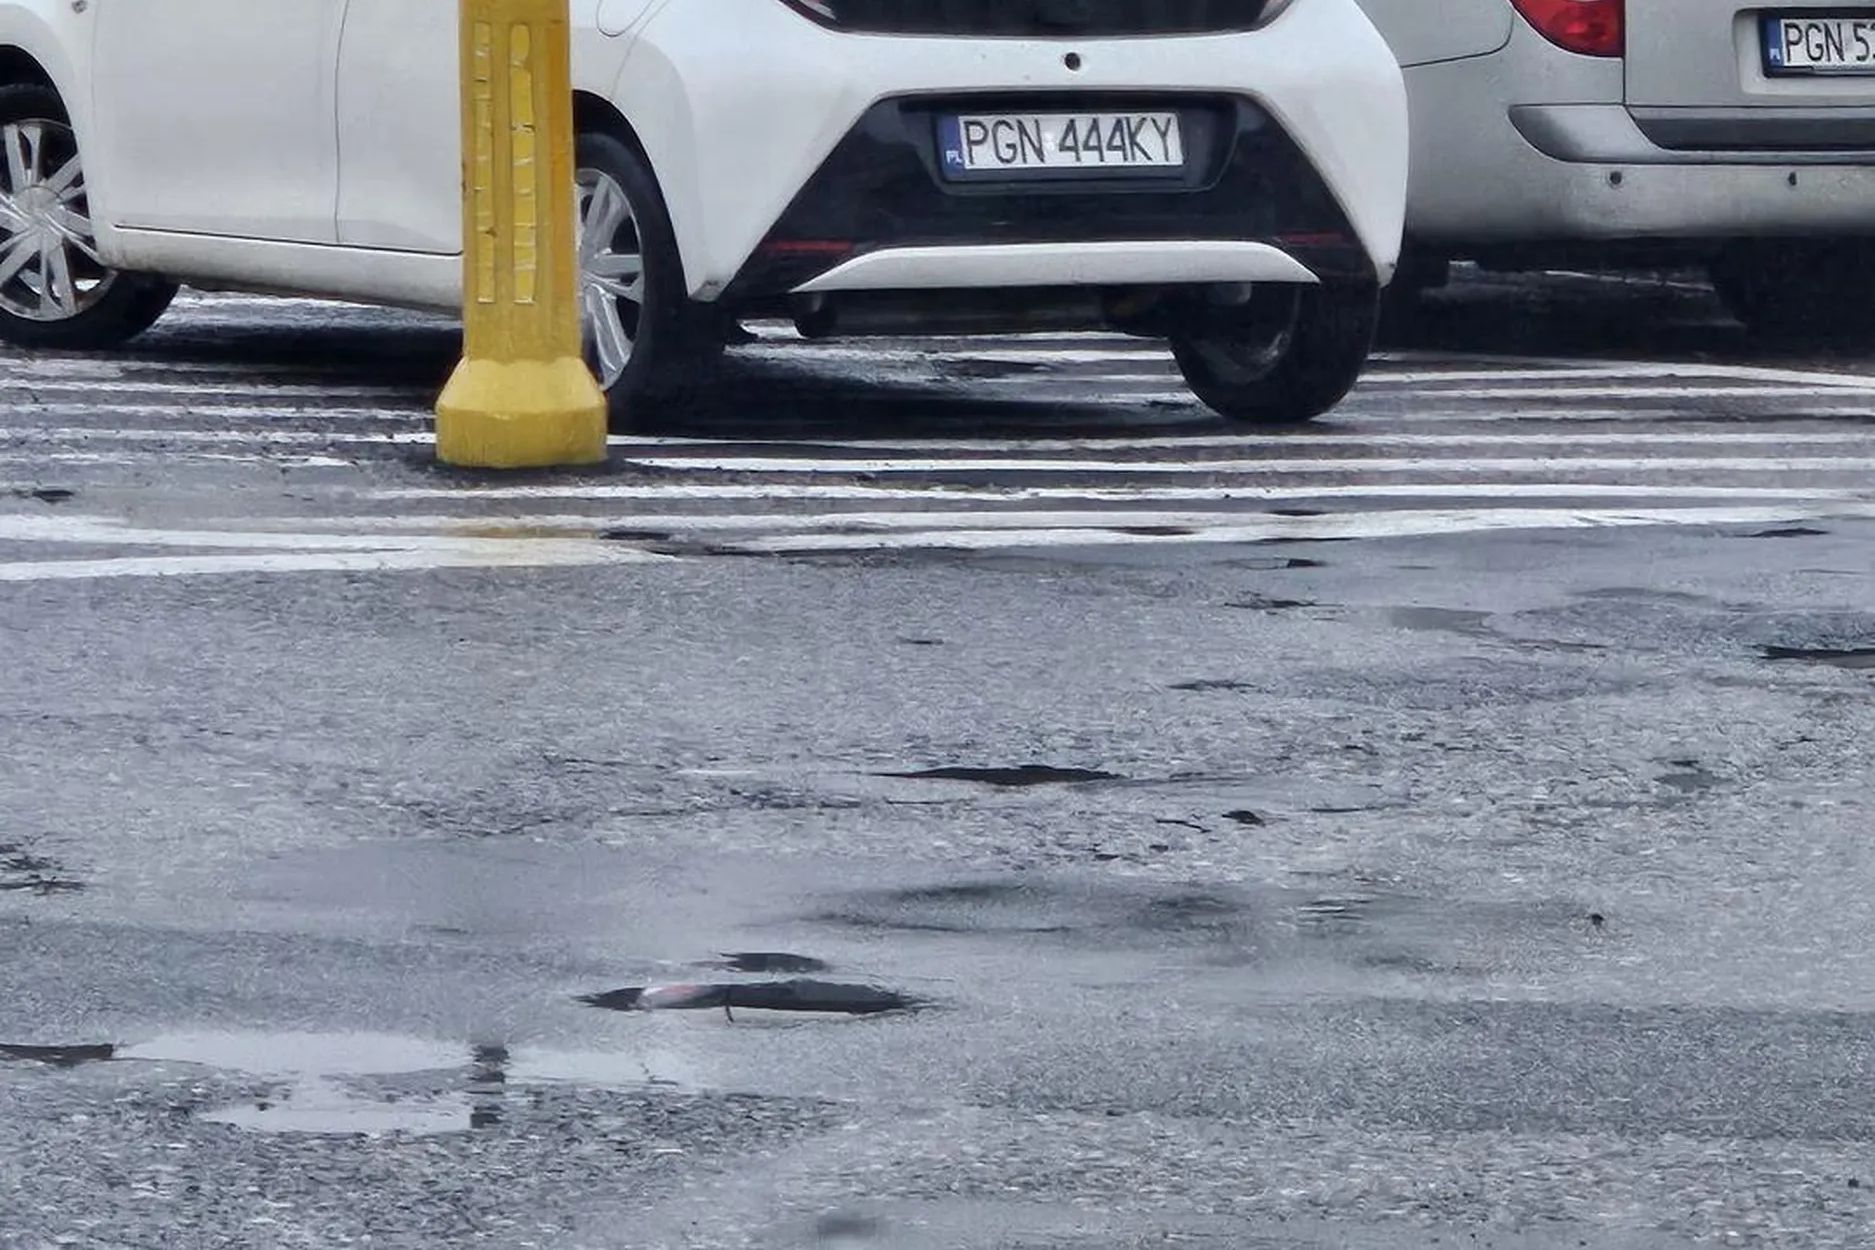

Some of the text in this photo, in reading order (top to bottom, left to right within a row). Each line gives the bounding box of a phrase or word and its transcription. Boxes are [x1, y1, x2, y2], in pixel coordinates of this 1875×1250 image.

[1784, 21, 1845, 63] PGN
[963, 116, 1173, 165] PGN 444KY
